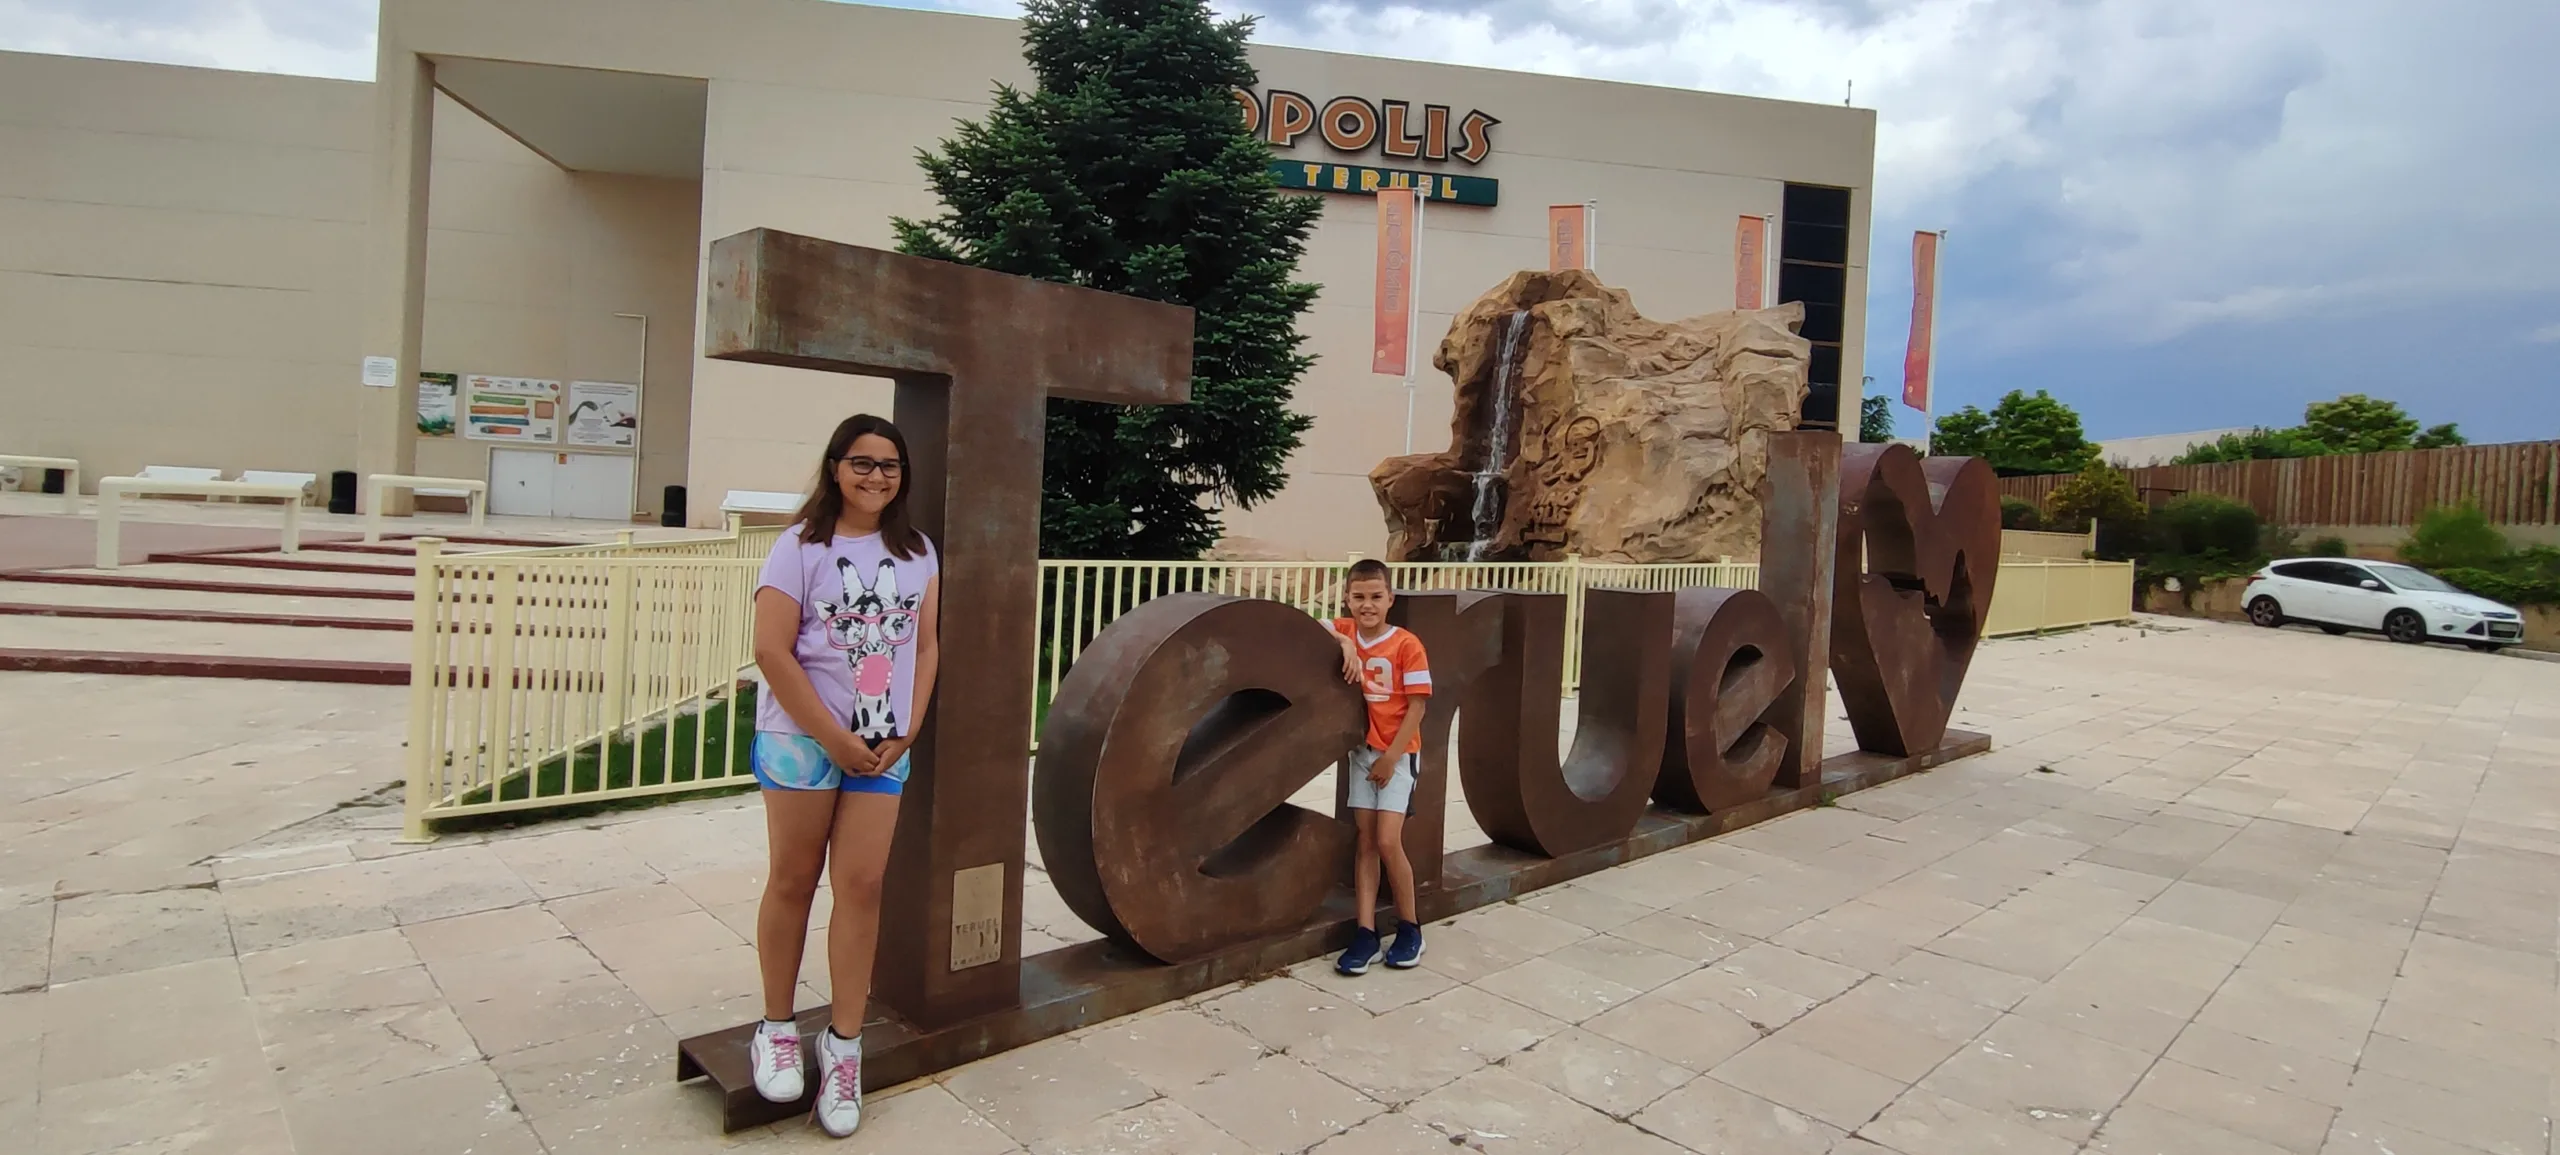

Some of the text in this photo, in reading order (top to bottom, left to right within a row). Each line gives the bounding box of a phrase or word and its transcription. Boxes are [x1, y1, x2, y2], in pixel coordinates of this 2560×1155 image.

[1303, 163, 1458, 199] TERUEL
[705, 227, 1842, 1032] Teruel
[956, 917, 999, 936] TERUEL
